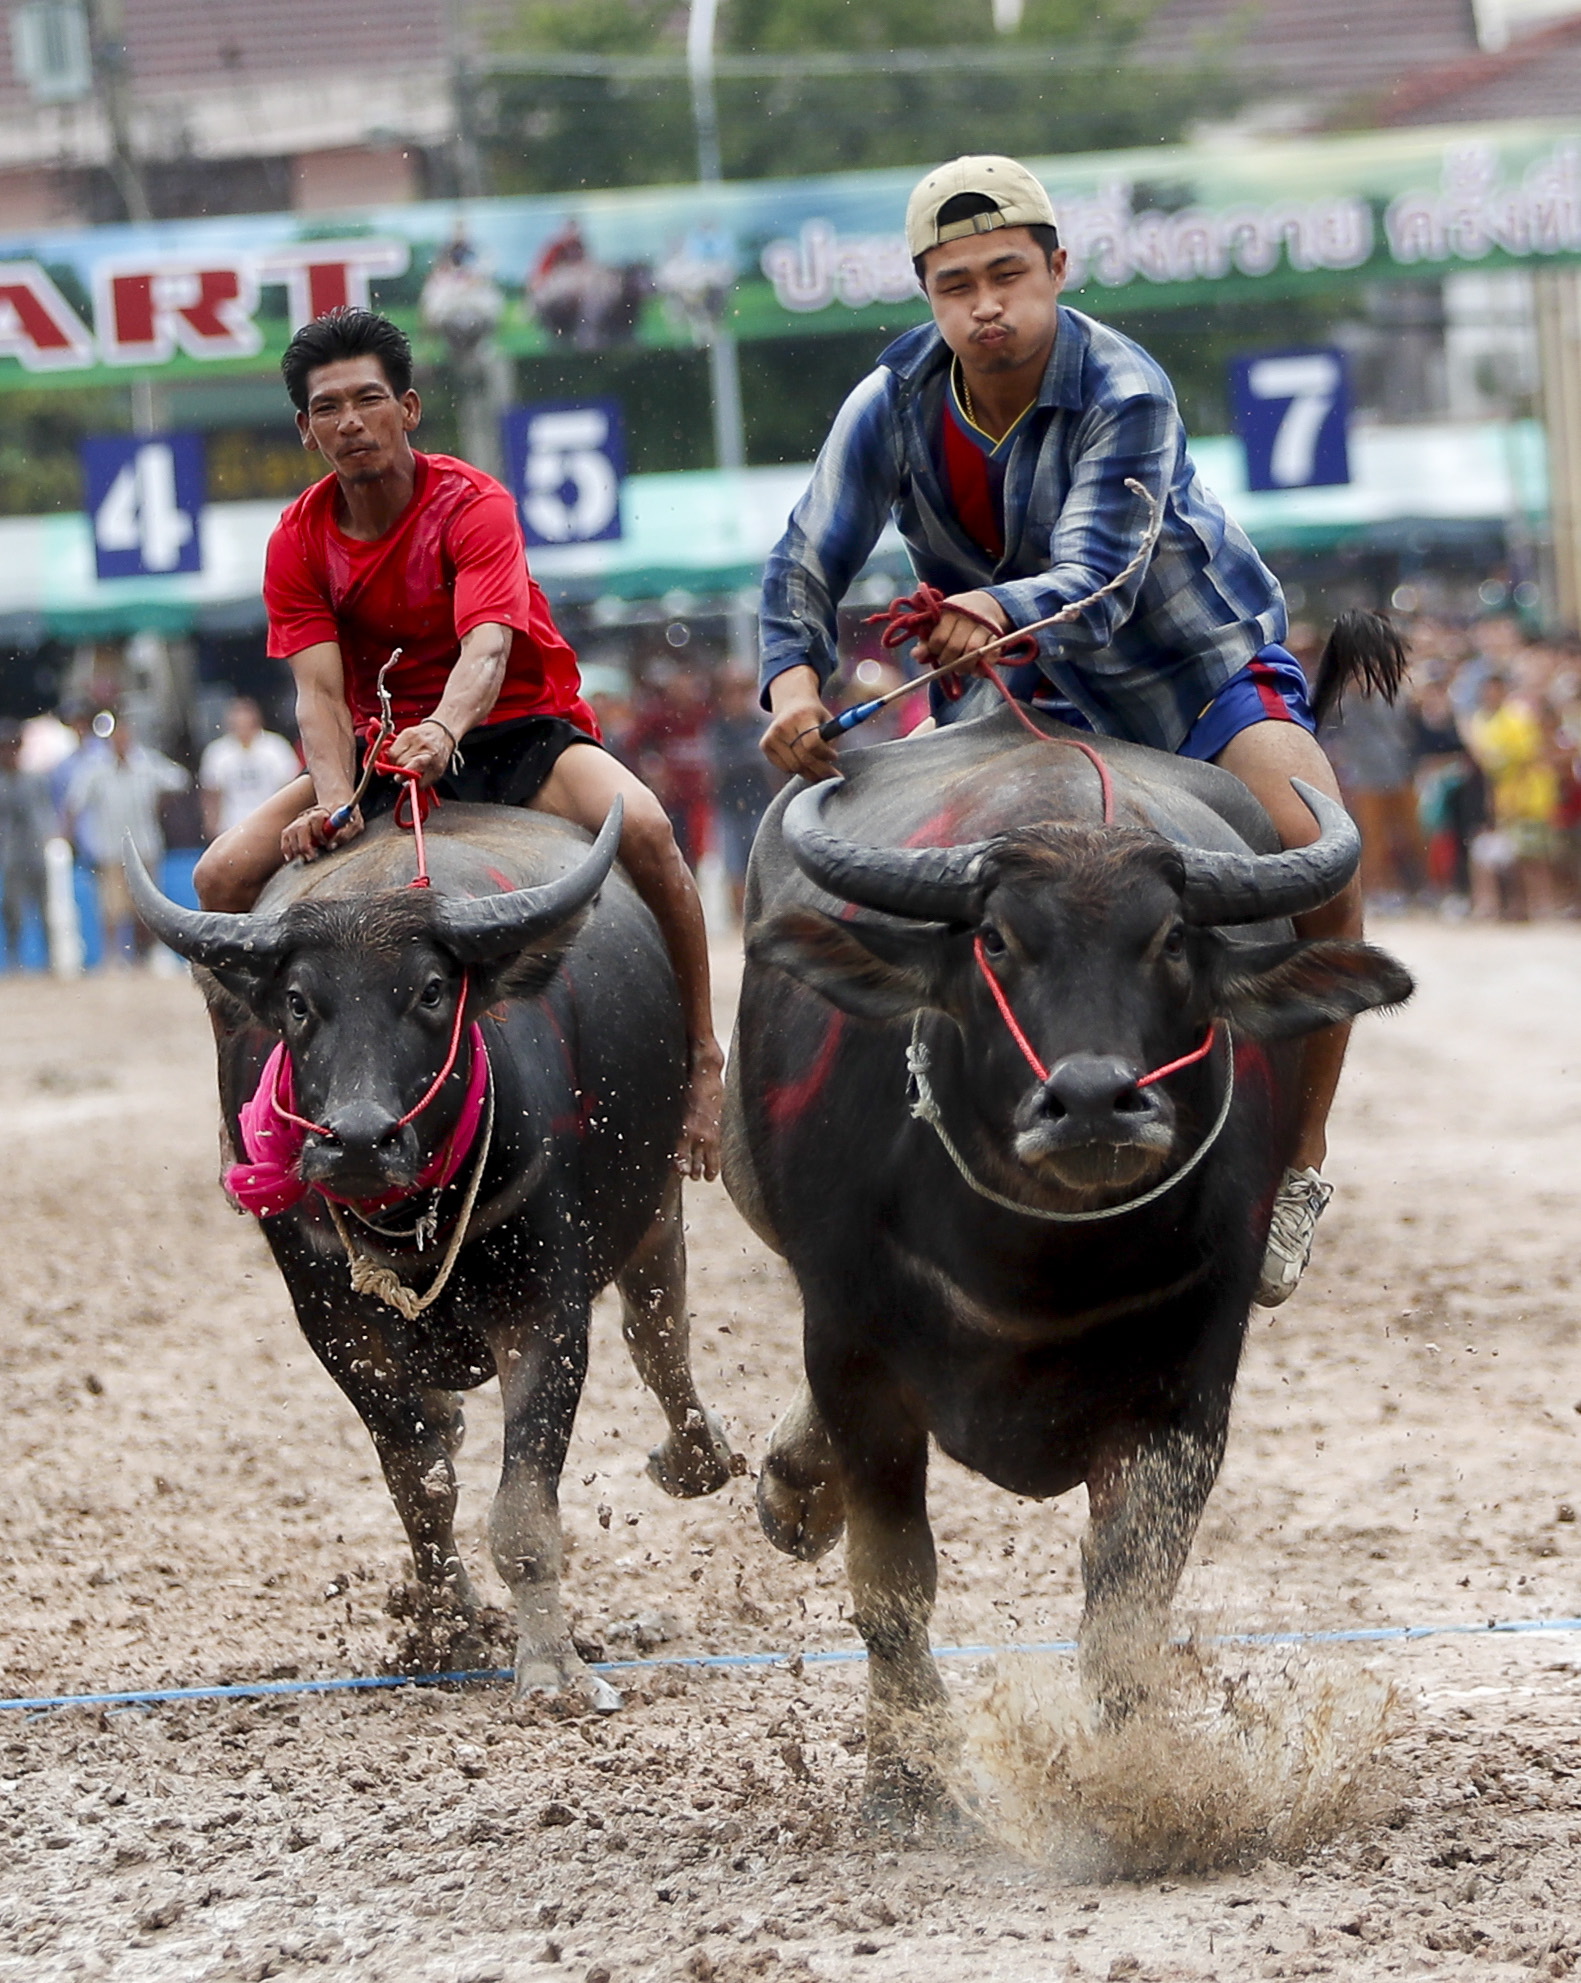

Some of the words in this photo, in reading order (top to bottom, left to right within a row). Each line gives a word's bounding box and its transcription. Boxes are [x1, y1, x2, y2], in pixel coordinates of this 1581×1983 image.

[524, 408, 618, 543] 5
[1248, 354, 1341, 487] 7
[95, 443, 194, 572] 4
